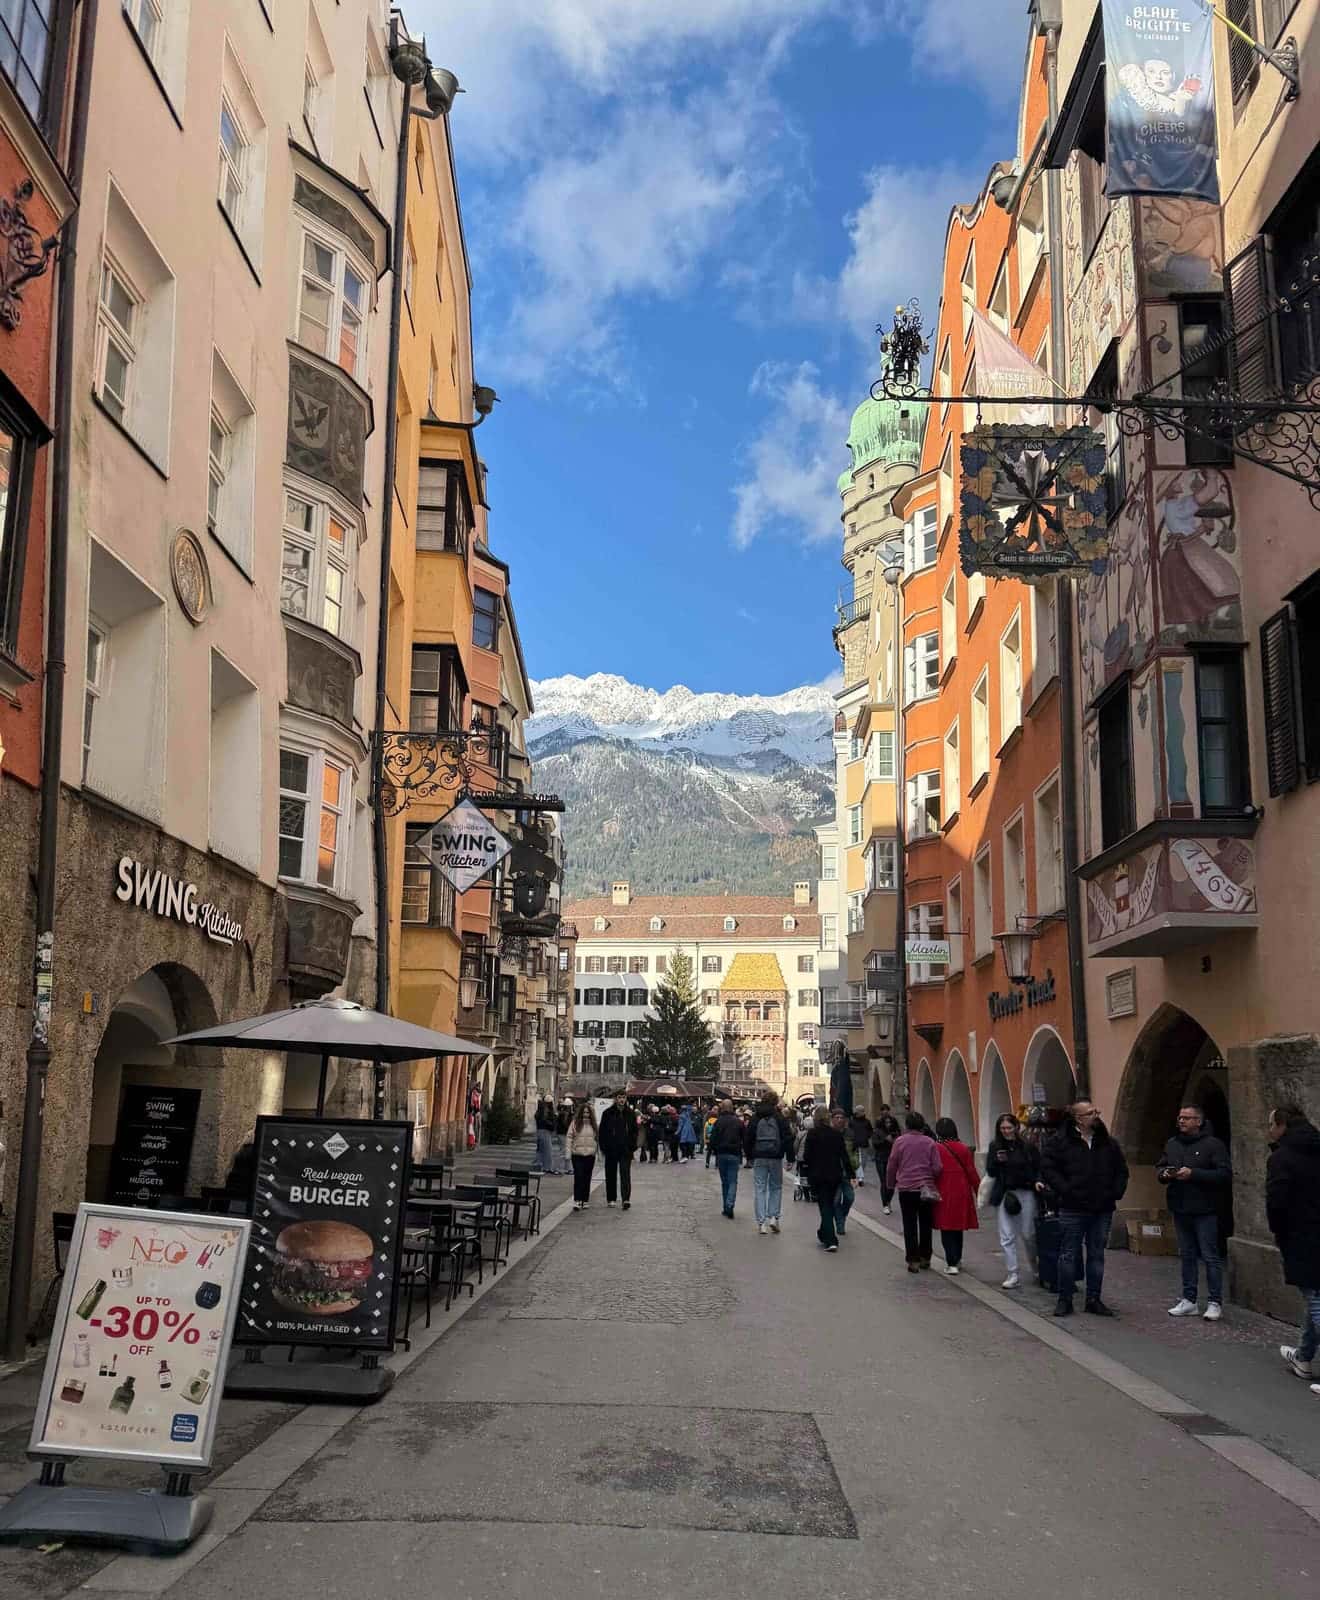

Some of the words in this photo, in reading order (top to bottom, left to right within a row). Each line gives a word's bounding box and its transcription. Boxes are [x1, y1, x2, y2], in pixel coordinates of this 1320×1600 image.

[1133, 6, 1180, 20] BLAUE
[1125, 15, 1192, 33] BRIGITTE
[1141, 121, 1185, 136] CHEERS
[432, 834, 497, 853] SWING
[440, 854, 487, 869] Kitchen
[116, 856, 198, 925] SWING
[199, 902, 243, 946] Kitchen
[145, 1101, 176, 1112] SWING
[301, 1167, 329, 1183] Real
[330, 1172, 364, 1186] vegan
[289, 1186, 370, 1207] BURGER
[129, 1235, 189, 1265] NEO
[136, 1296, 151, 1305] UP
[155, 1297, 171, 1306] TO
[89, 1305, 200, 1345] -30%
[276, 1320, 296, 1330] 100%
[297, 1323, 323, 1332] PLANT
[323, 1324, 350, 1334] BASED
[129, 1344, 154, 1356] OFF
